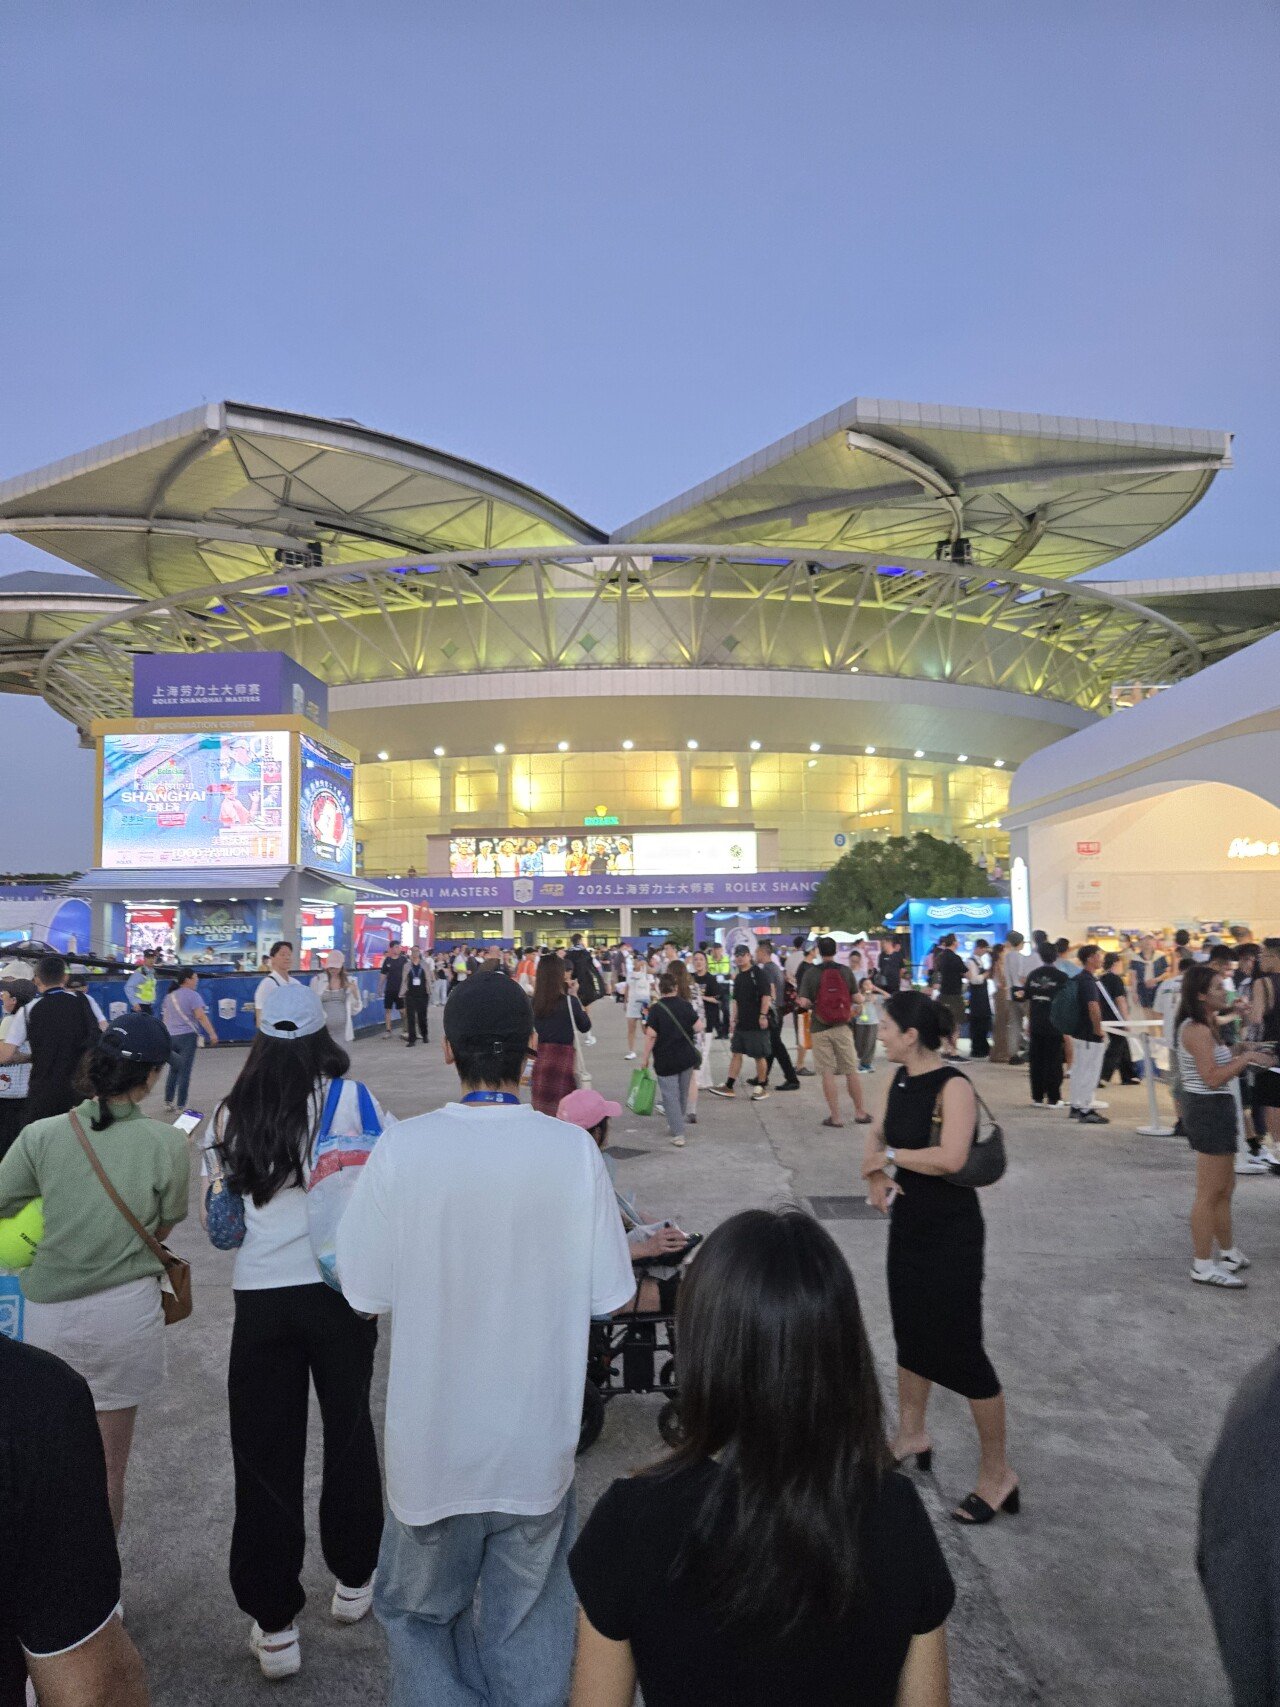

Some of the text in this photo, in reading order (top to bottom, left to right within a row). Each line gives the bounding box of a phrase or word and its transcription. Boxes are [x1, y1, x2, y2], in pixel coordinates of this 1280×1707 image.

[152, 684, 261, 698] 上海劳力士大师赛
[154, 720, 256, 731] INFORMATION CENTER
[121, 791, 206, 803] SHANGHAI
[439, 886, 498, 897] MASTERS
[577, 882, 715, 896] 2025上海劳力士大师赛
[725, 882, 766, 893] ROLEX
[184, 925, 253, 935] SHANGHAI
